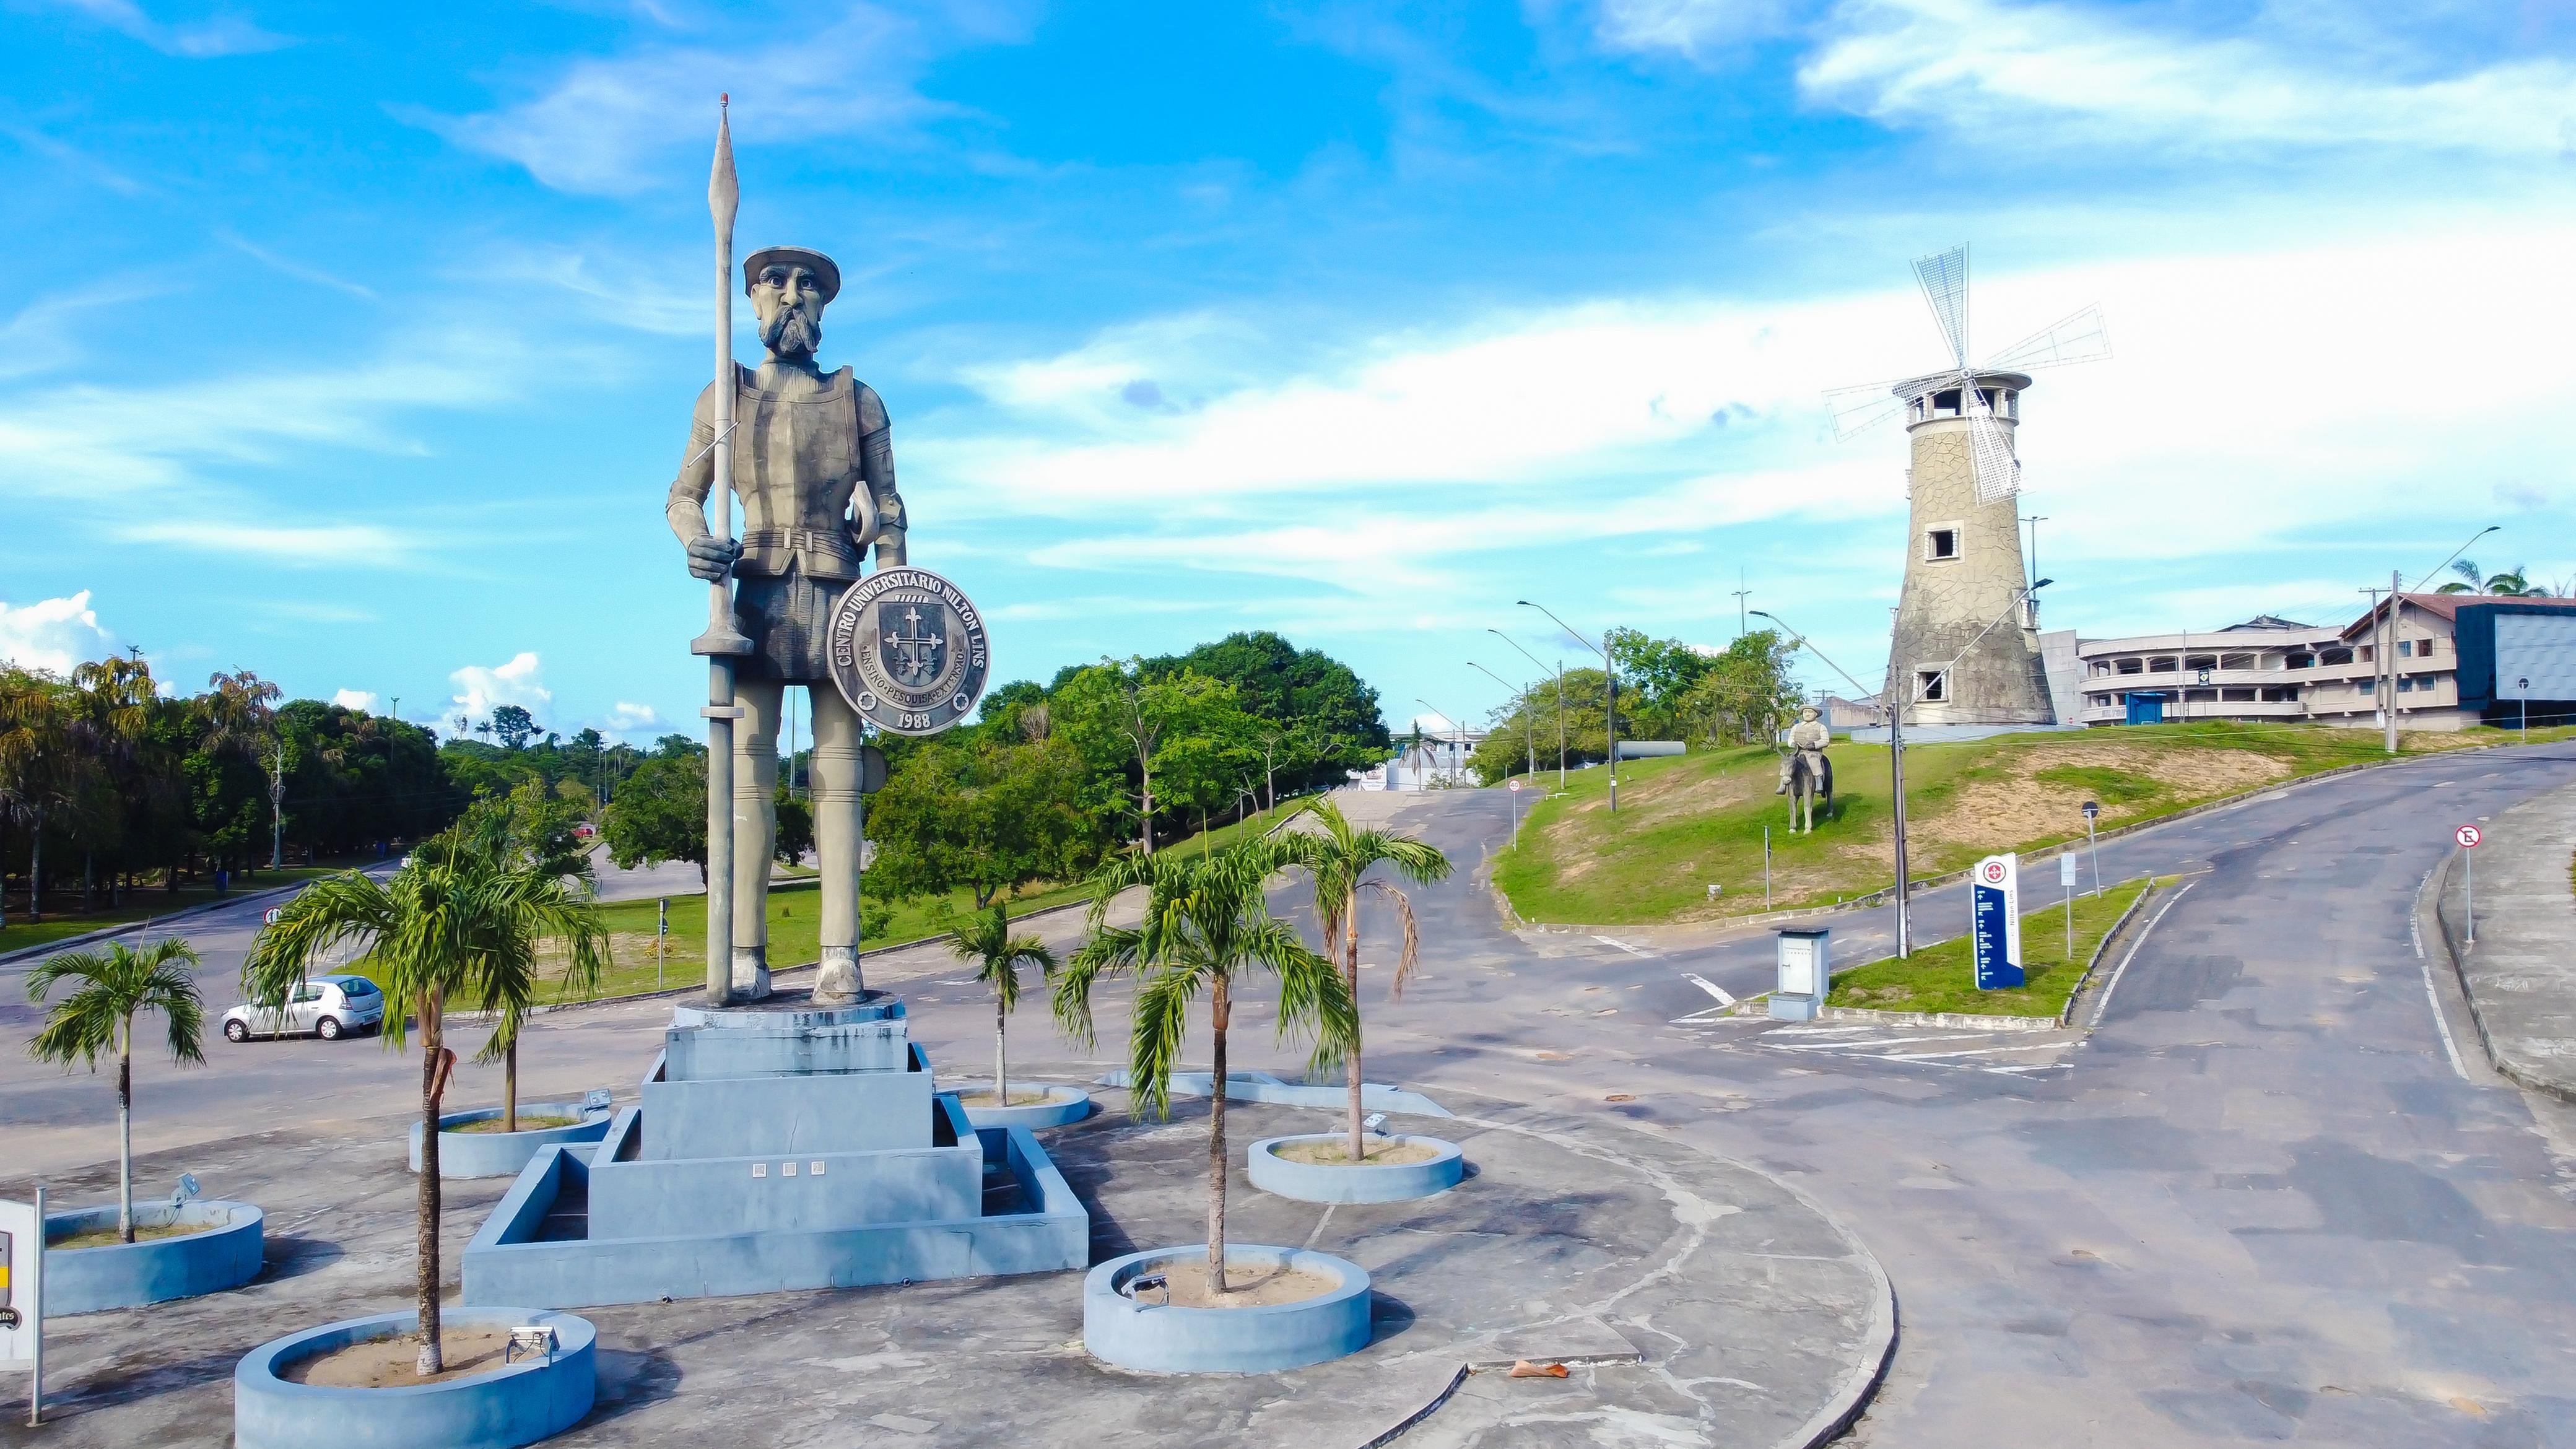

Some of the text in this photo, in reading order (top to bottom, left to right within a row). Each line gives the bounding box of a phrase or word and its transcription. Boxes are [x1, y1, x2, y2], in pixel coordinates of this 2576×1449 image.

[836, 572, 985, 668] CENTRO UNIVERSITÁRIO NILTON LINS
[861, 648, 886, 687] ENSINO
[886, 685, 934, 705] PESQUISA
[897, 712, 931, 729] 1988
[2465, 830, 2474, 842] E
